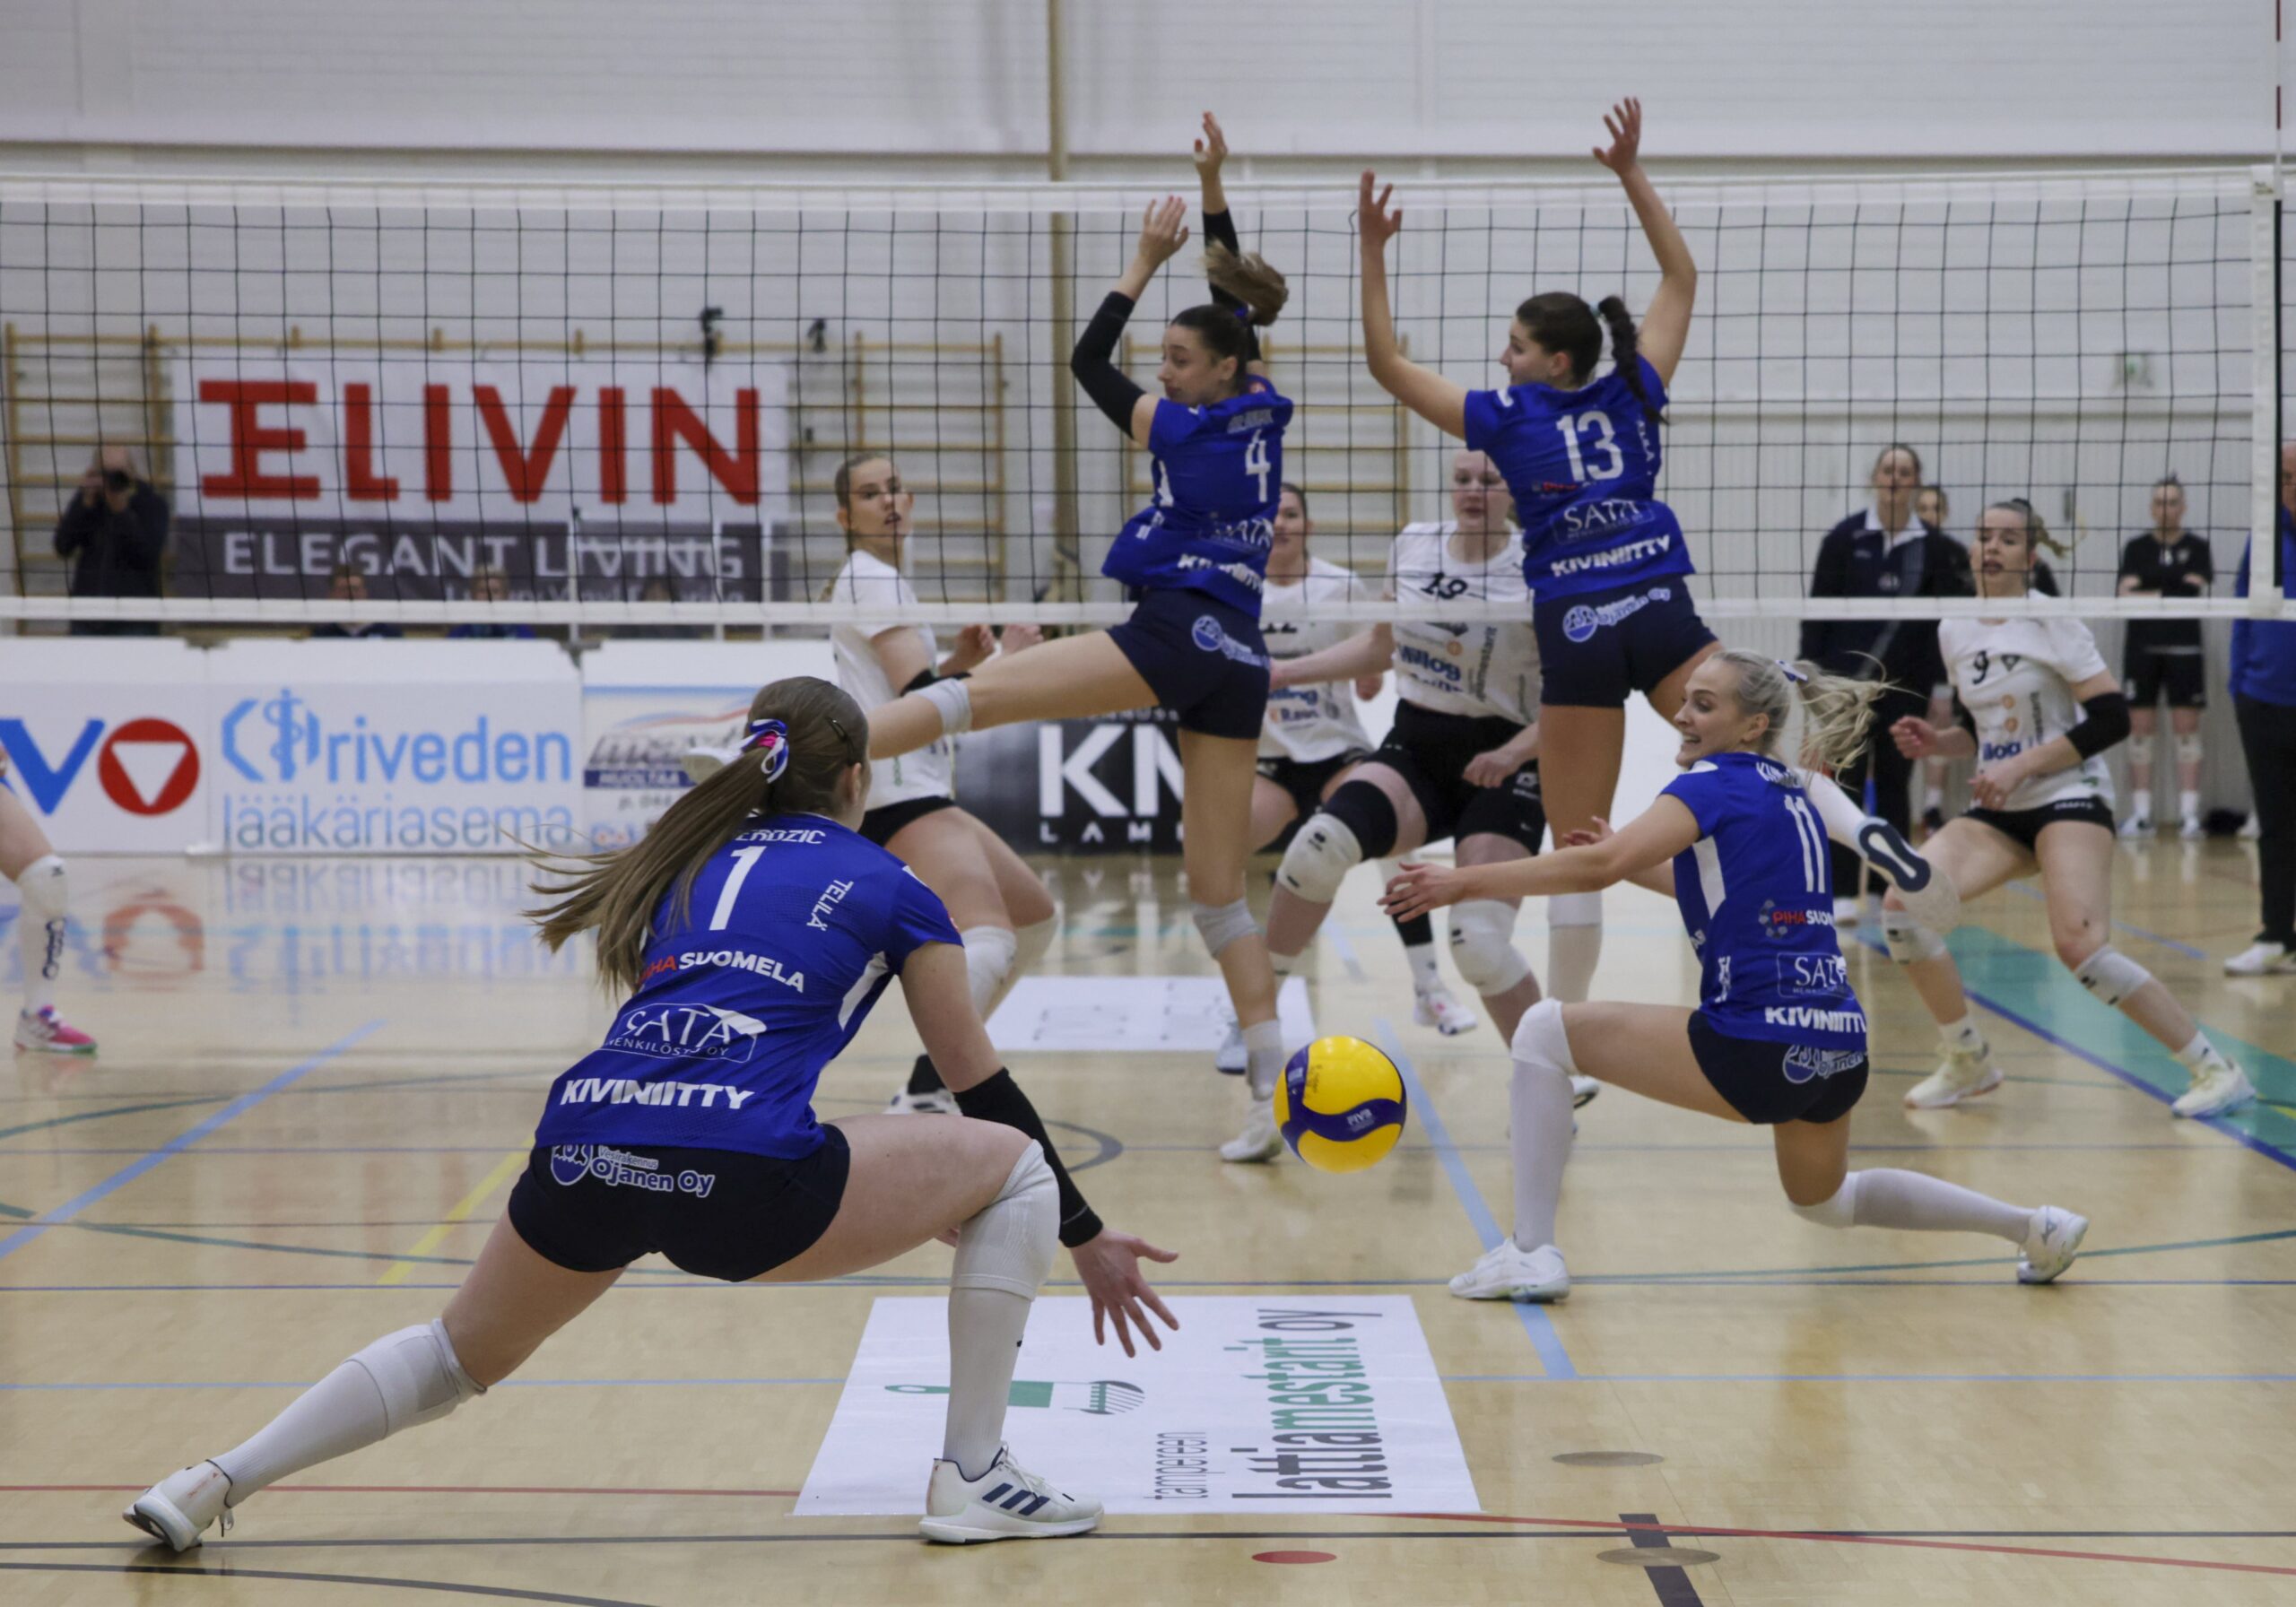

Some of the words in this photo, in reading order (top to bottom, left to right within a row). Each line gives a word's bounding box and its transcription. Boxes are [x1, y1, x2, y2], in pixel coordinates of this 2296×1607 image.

[199, 379, 761, 506] ELIVIN
[1245, 429, 1271, 503] 4
[1556, 411, 1623, 482] 13
[224, 533, 518, 576] ELEGANT
[1972, 649, 1989, 684] 9
[224, 795, 572, 848] lääkäriasema
[1784, 795, 1825, 893] 11
[709, 846, 767, 930] 1
[806, 880, 854, 931] TELILÄ
[622, 1007, 732, 1048] SATA
[560, 1078, 755, 1110] KIVINIITTY
[591, 1158, 674, 1193] Ojanen
[678, 1170, 716, 1198] Oy
[1257, 1308, 1383, 1332] oy
[1223, 1337, 1393, 1498] lattiamestarit
[1144, 1431, 1227, 1500] tampereen
